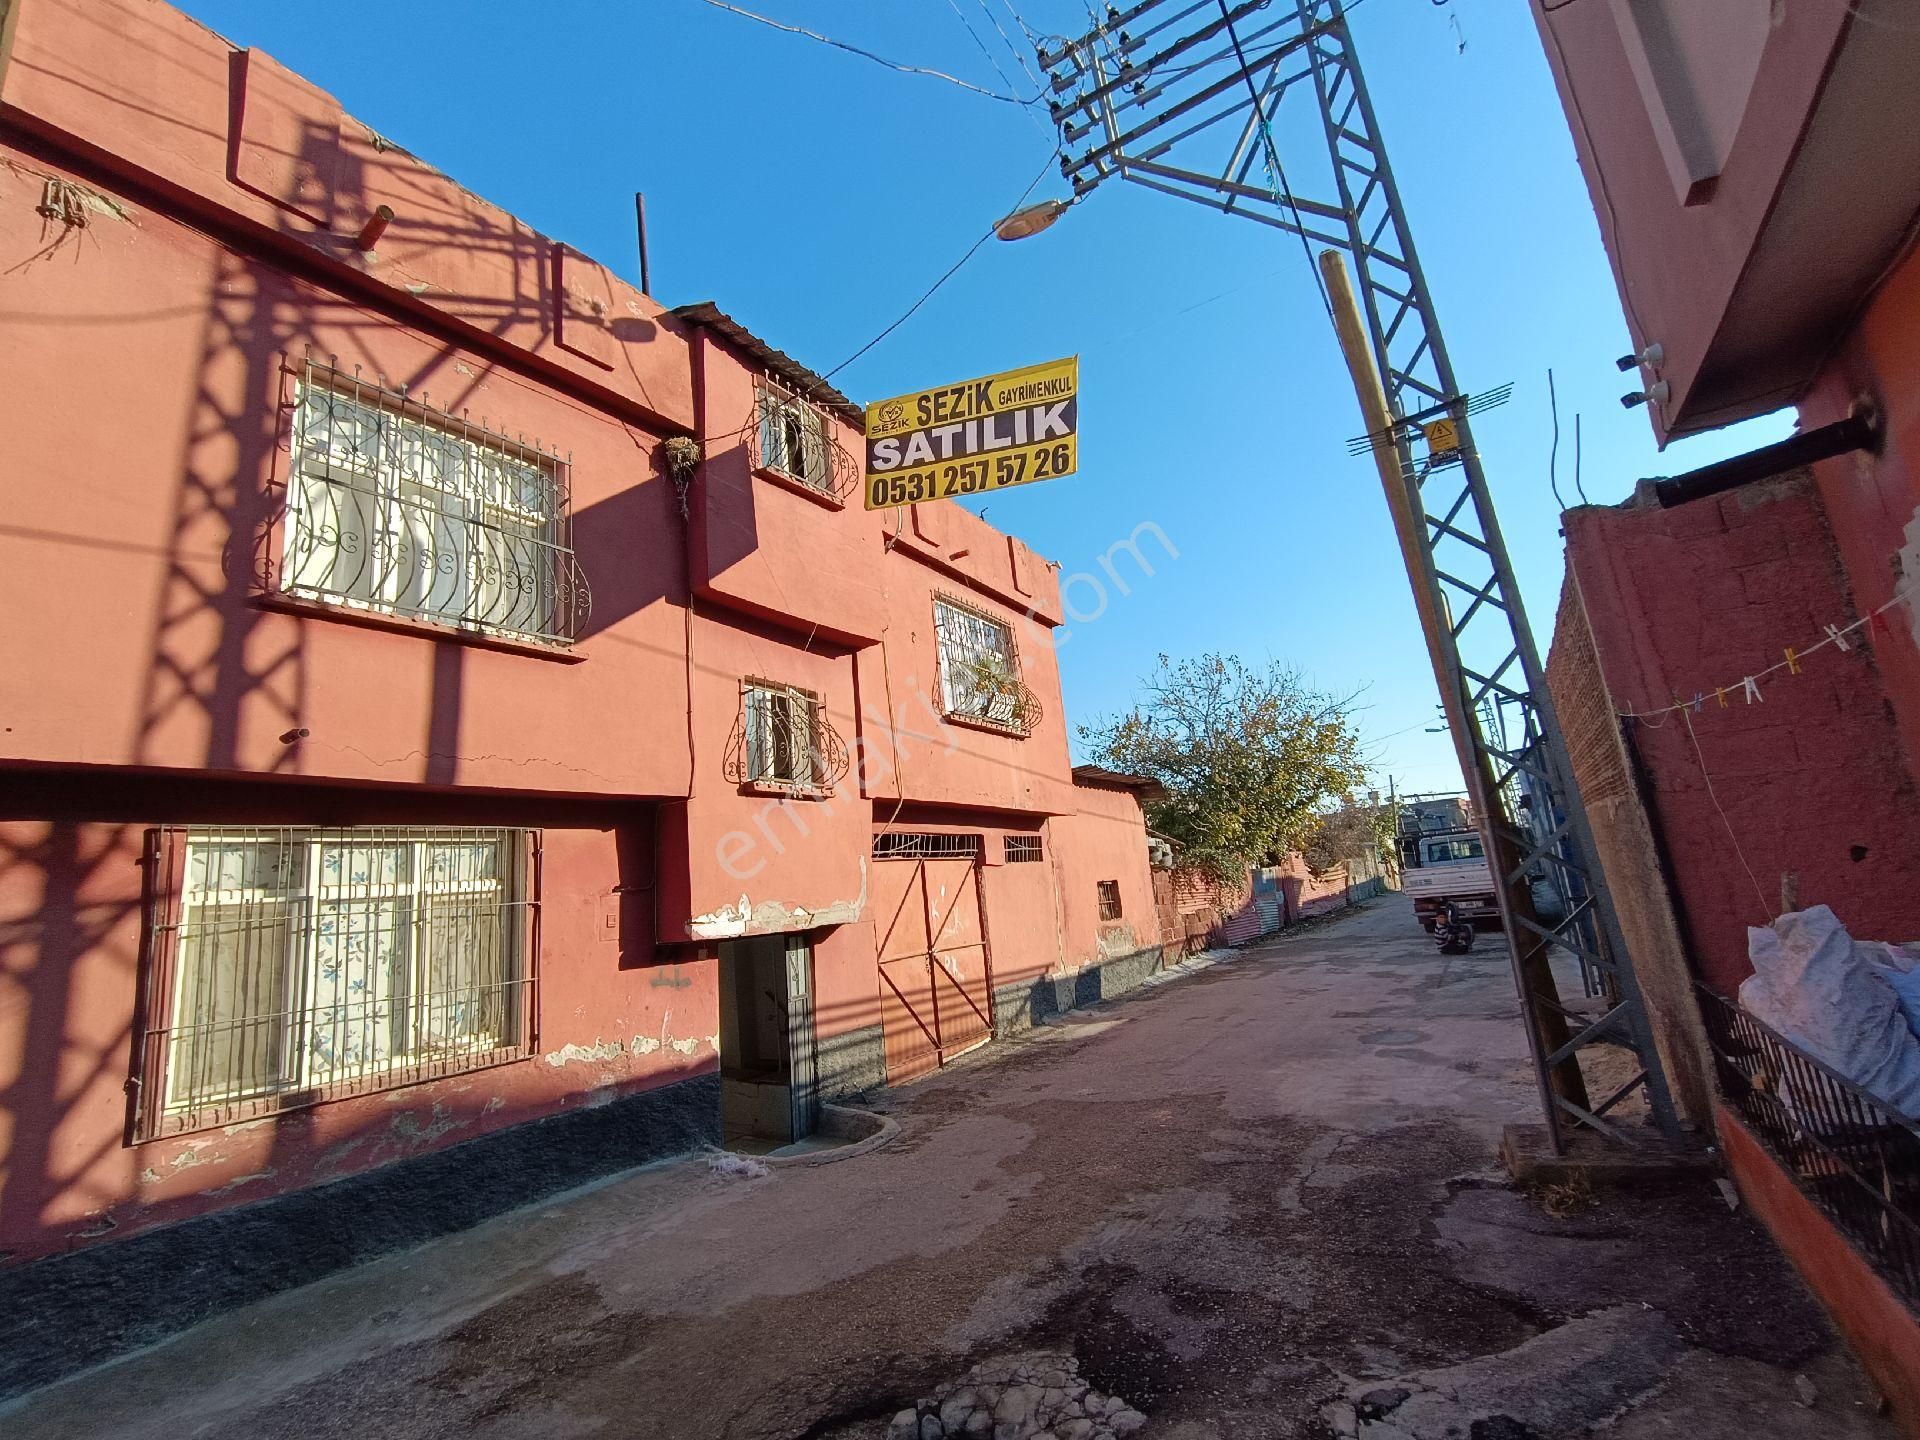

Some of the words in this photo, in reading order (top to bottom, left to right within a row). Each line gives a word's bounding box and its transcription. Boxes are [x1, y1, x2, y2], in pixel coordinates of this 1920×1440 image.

[998, 375, 1073, 406] GAYRİMENKUL
[872, 400, 1071, 471] SATILIK
[872, 473, 937, 506] 0531
[943, 459, 990, 496] 257
[996, 452, 1028, 486] 57
[1033, 443, 1070, 479] 26
